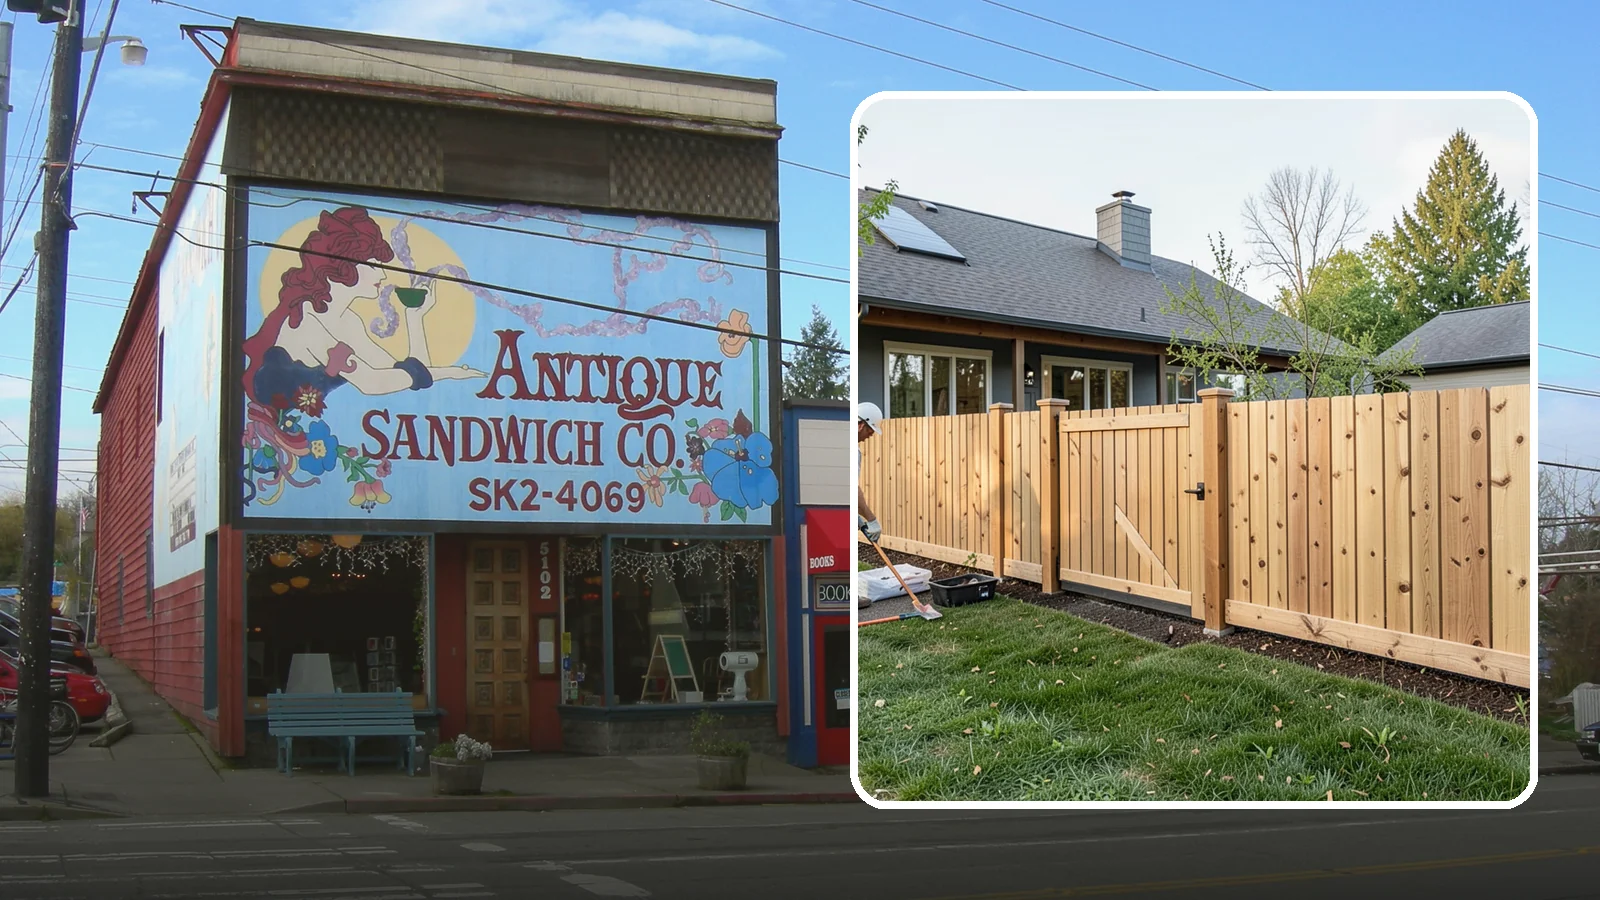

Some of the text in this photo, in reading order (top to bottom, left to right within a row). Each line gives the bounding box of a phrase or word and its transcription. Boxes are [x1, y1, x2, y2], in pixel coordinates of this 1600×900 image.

[475, 329, 724, 421] ANTIQUE
[361, 408, 685, 469] SANDWICH CO.
[468, 476, 646, 513] SK2-4069
[540, 541, 552, 600] 5102
[809, 555, 834, 568] BOOKS
